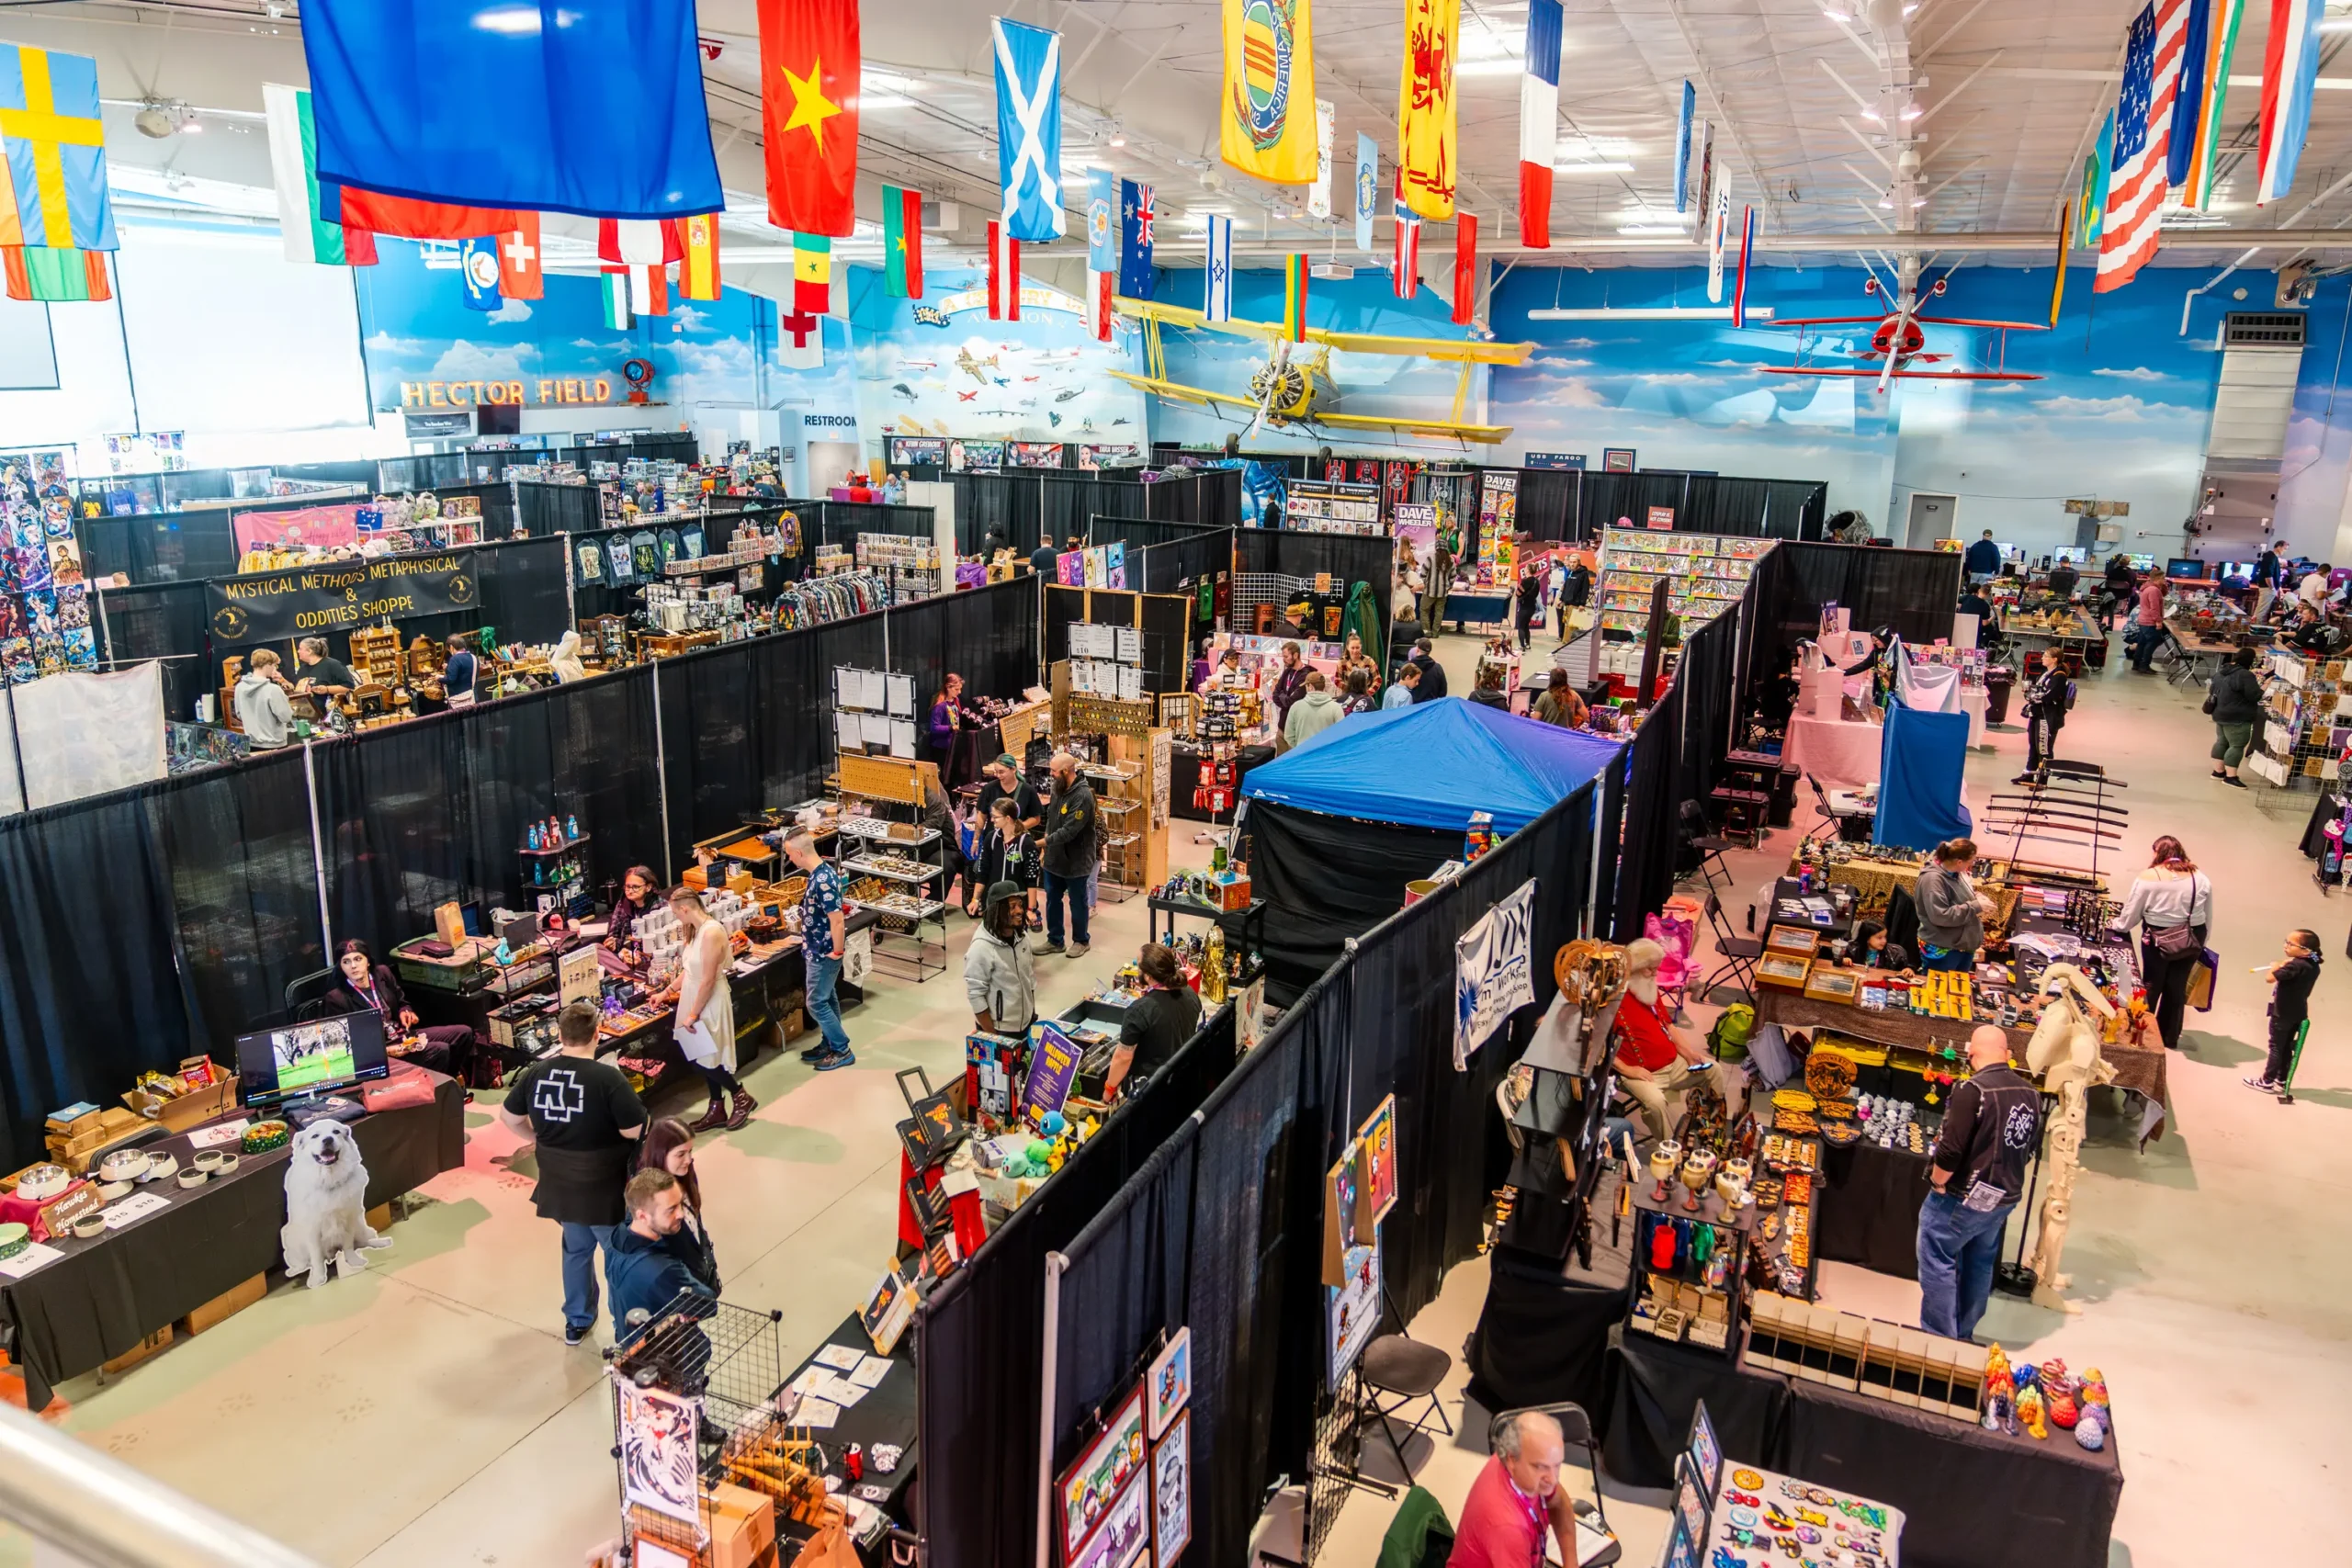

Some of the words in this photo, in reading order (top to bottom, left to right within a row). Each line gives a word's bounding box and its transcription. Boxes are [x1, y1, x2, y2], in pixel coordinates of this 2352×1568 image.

[404, 380, 525, 407] HECTOR
[538, 378, 612, 404] FIELD
[1398, 518, 1432, 528] WHEELER
[225, 577, 297, 600] MYSTICAL
[301, 570, 365, 590] METHODS
[369, 557, 460, 580] METAPHYSICAL
[345, 588, 358, 602] &
[296, 605, 358, 629] ODDITIES
[362, 595, 414, 618] SHOPPE
[186, 1069, 205, 1078] CHEWY
[933, 1111, 949, 1122] KOI
[54, 1190, 88, 1215] Hawkes
[108, 1211, 129, 1222] $15
[135, 1198, 155, 1209] $10
[55, 1198, 99, 1233] Homestead
[17, 1254, 35, 1265] $25
